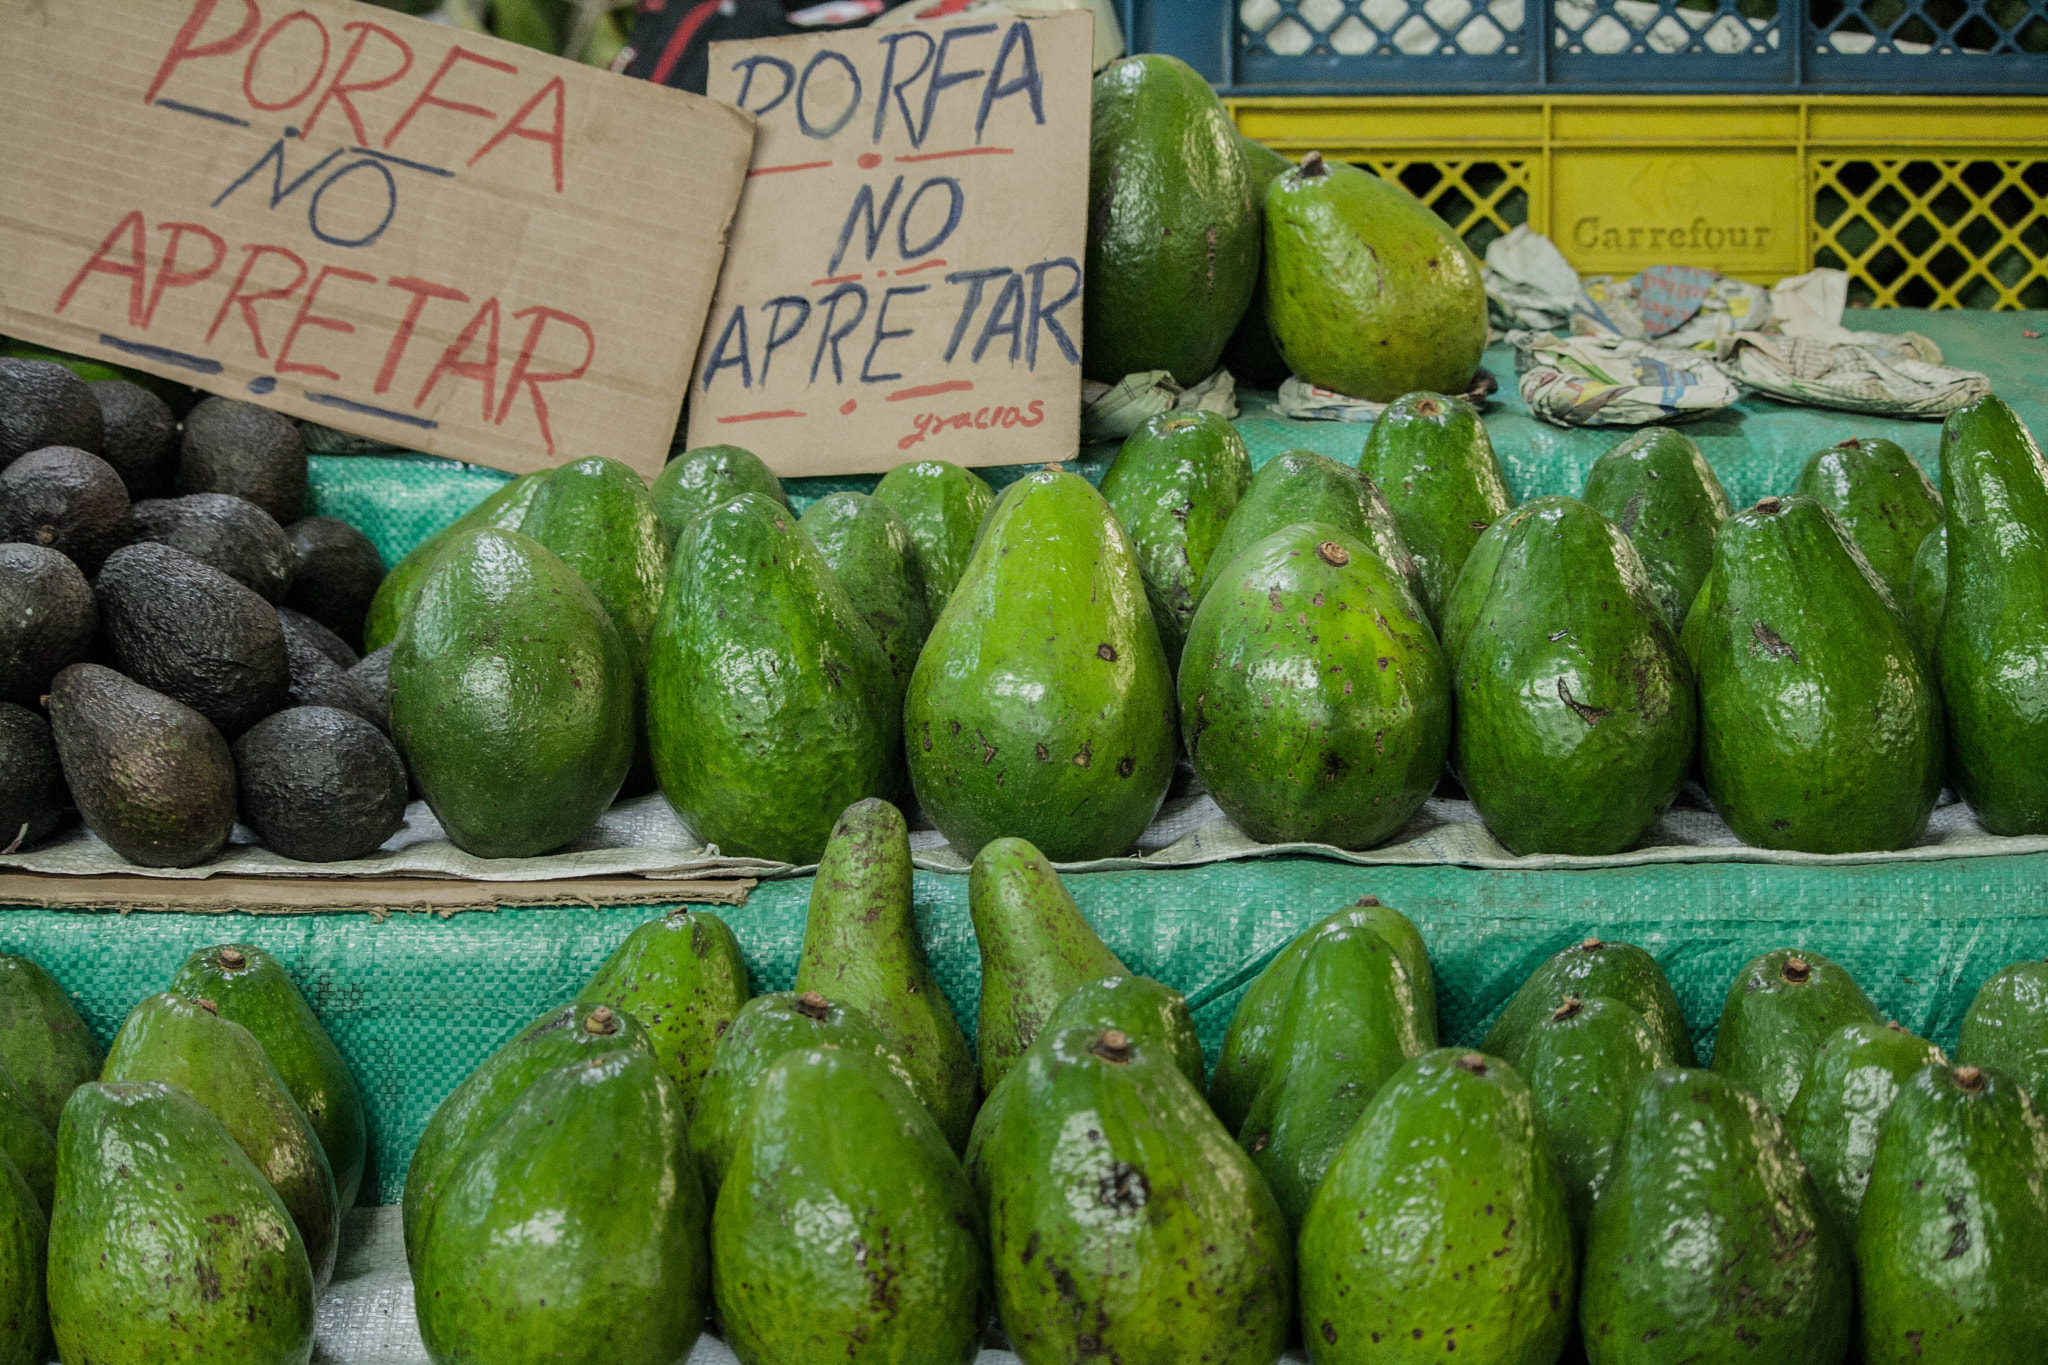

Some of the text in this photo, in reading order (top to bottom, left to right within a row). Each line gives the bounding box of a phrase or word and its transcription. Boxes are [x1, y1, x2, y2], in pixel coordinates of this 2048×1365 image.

[143, 0, 566, 194] PORFA
[731, 21, 1046, 149] PORFA
[210, 138, 398, 247] NO
[827, 175, 965, 277] NO
[1572, 215, 1772, 249] Carrefour
[54, 210, 595, 456] APRETAR
[702, 256, 1084, 393] APRETAR
[897, 400, 1045, 450] gracias
